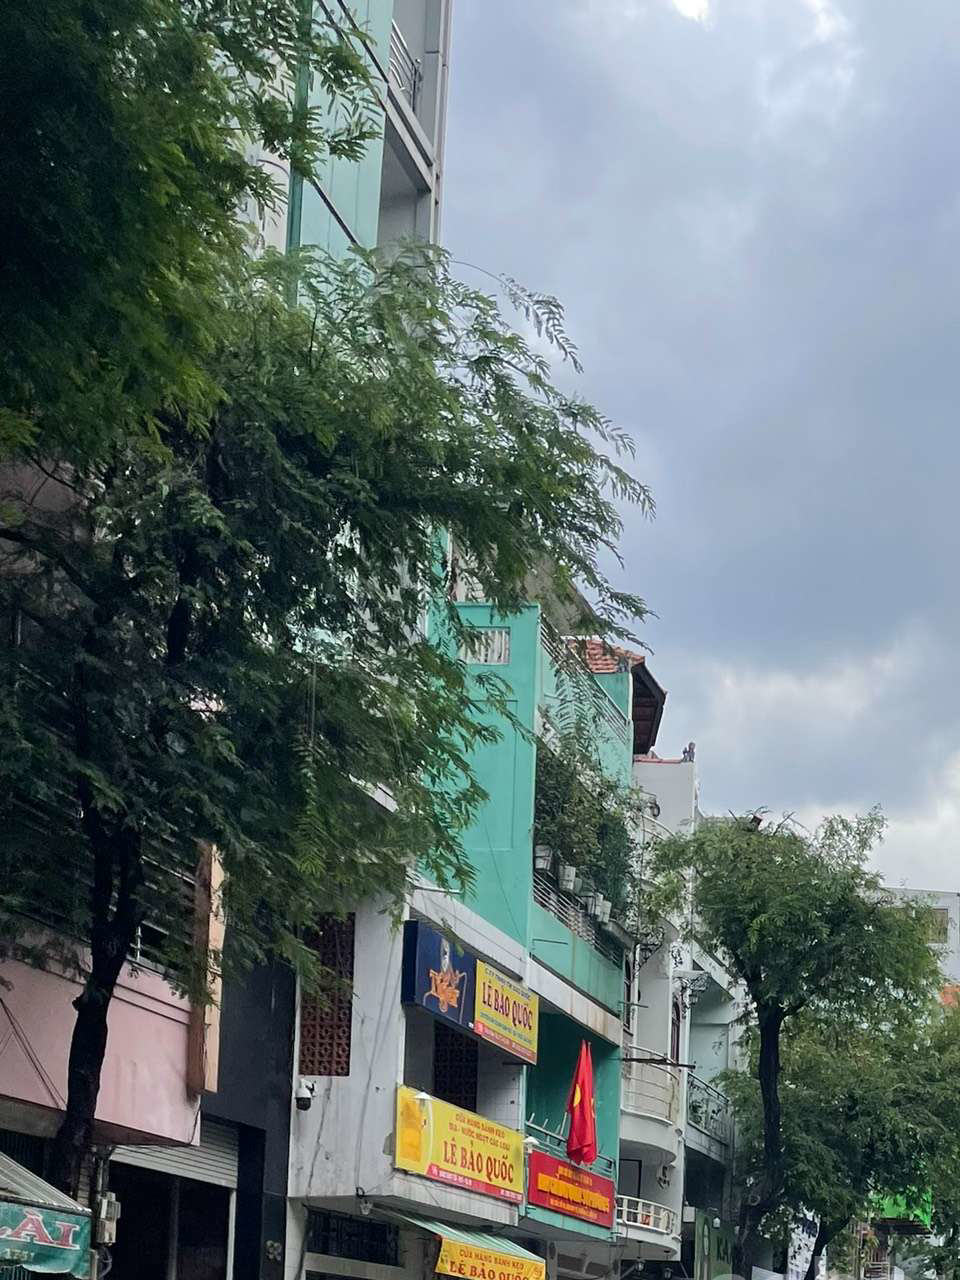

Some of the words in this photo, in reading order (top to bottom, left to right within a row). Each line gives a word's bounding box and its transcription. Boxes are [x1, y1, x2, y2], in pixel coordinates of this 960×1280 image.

[443, 1136, 457, 1166] LÊ
[460, 1140, 483, 1174] BẢO
[485, 1153, 515, 1184] QUỐC
[449, 1259, 466, 1276] LÊ
[469, 1262, 496, 1280] BẢO
